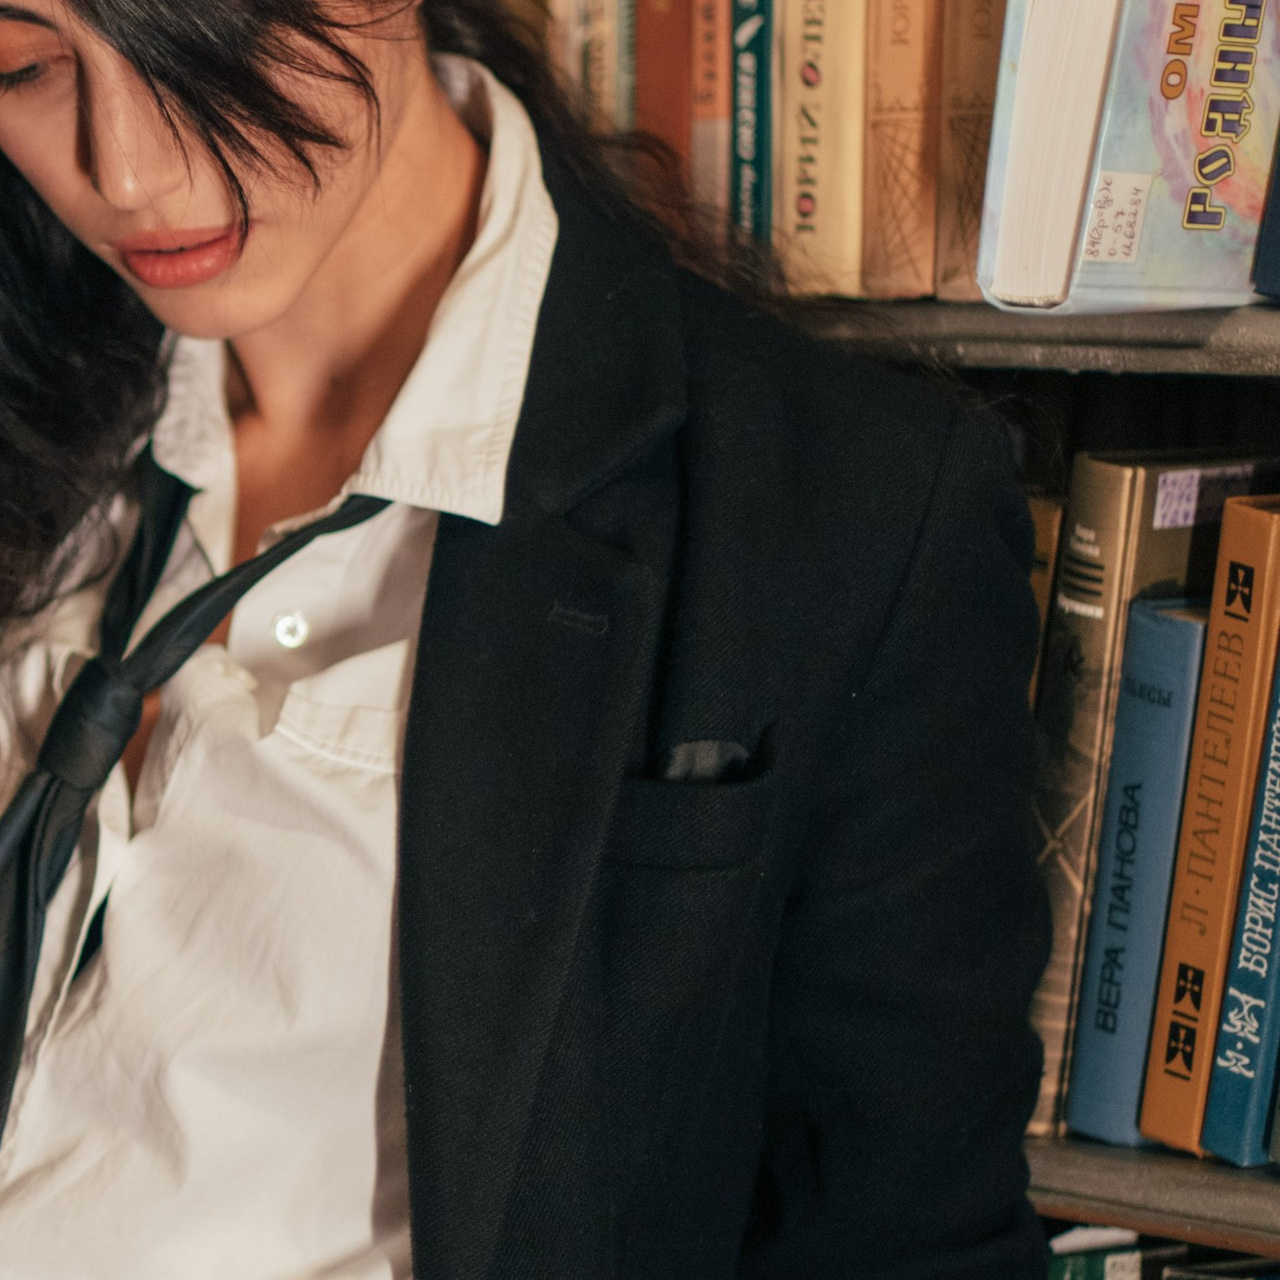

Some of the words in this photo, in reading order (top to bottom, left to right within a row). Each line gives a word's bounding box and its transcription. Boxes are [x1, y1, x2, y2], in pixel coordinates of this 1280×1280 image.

[1158, 2, 1200, 102] ОМ
[1186, 629, 1246, 885] ПАНТЕЛЕЕВ
[1104, 780, 1142, 933] ПАНОВА
[1237, 875, 1280, 978] БОРИС
[1094, 945, 1127, 1035] ВЕРА
